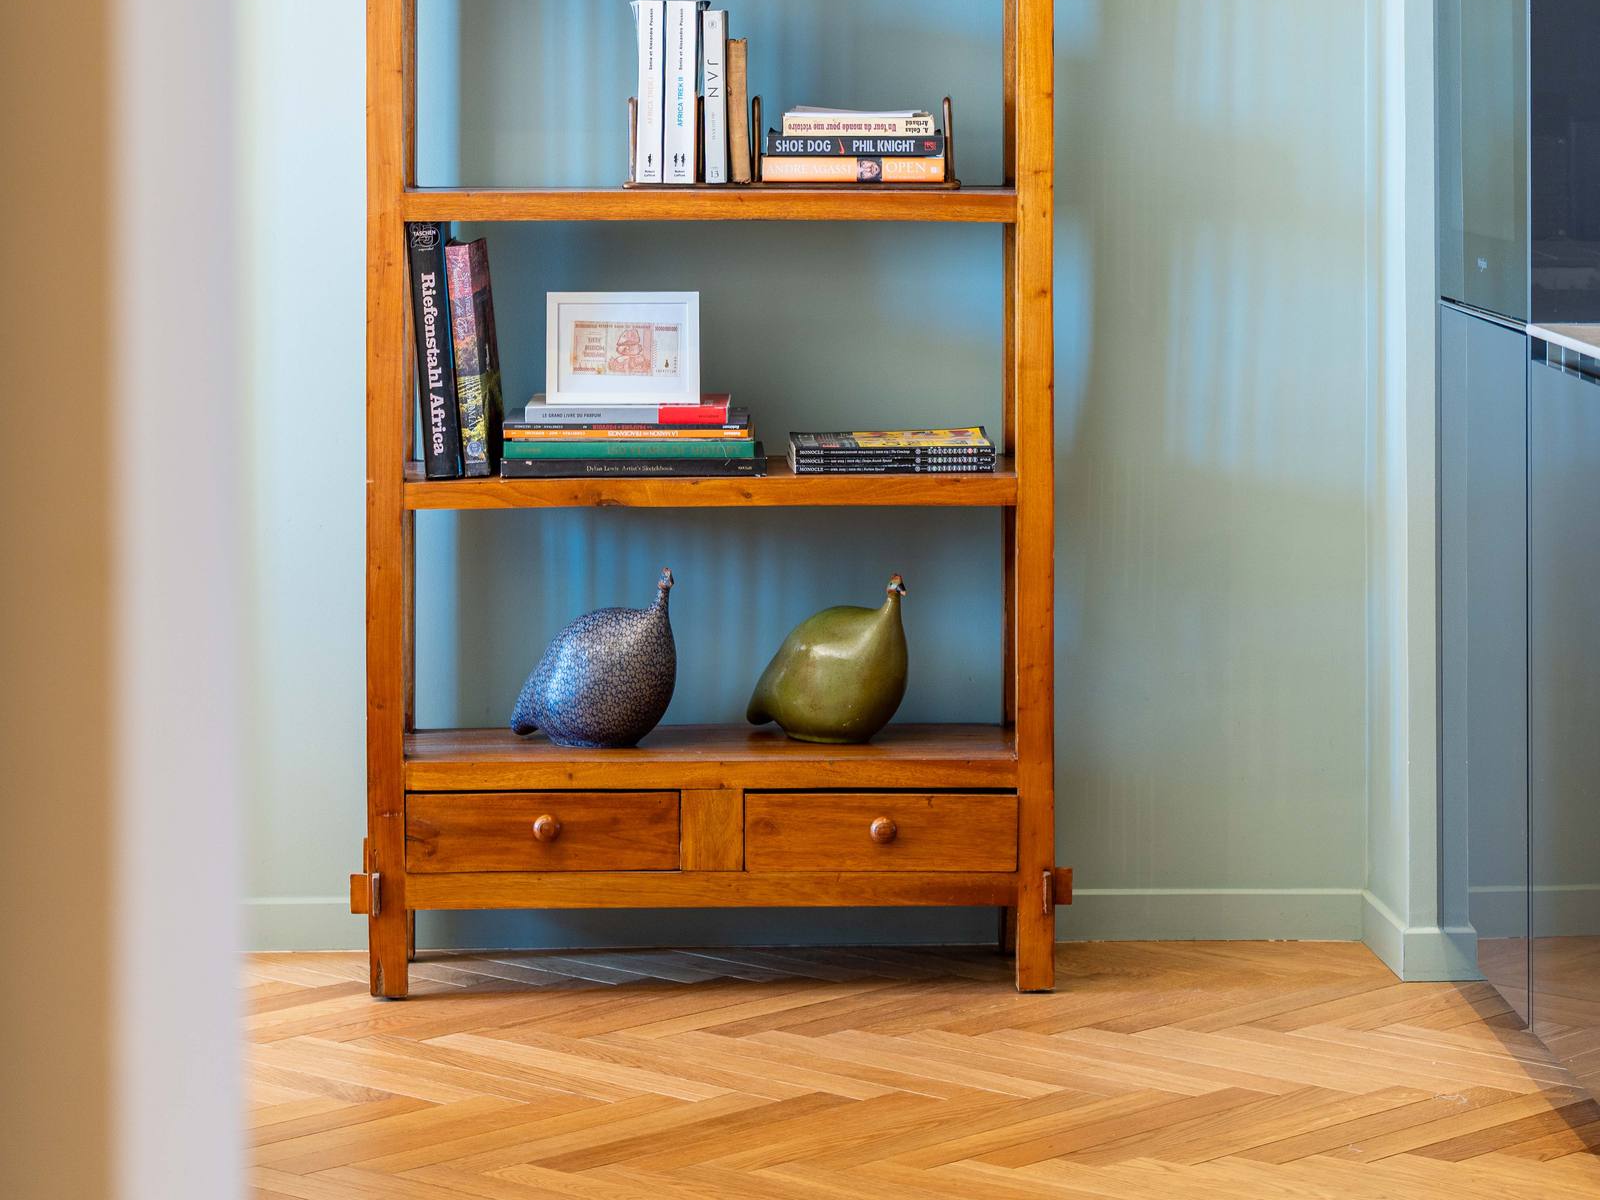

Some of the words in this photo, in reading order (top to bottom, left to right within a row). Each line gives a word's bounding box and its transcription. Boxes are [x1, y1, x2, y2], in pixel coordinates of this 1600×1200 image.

[707, 59, 719, 98] JAN
[788, 123, 812, 131] victoire
[825, 122, 841, 131] pour
[775, 140, 804, 153] SHOE
[807, 140, 831, 152] DOG
[853, 140, 875, 152] PHIL
[877, 140, 915, 152] KNIGHT
[886, 161, 925, 174] OPEN
[421, 272, 443, 389] Riefenstahl
[430, 393, 446, 455] Africa
